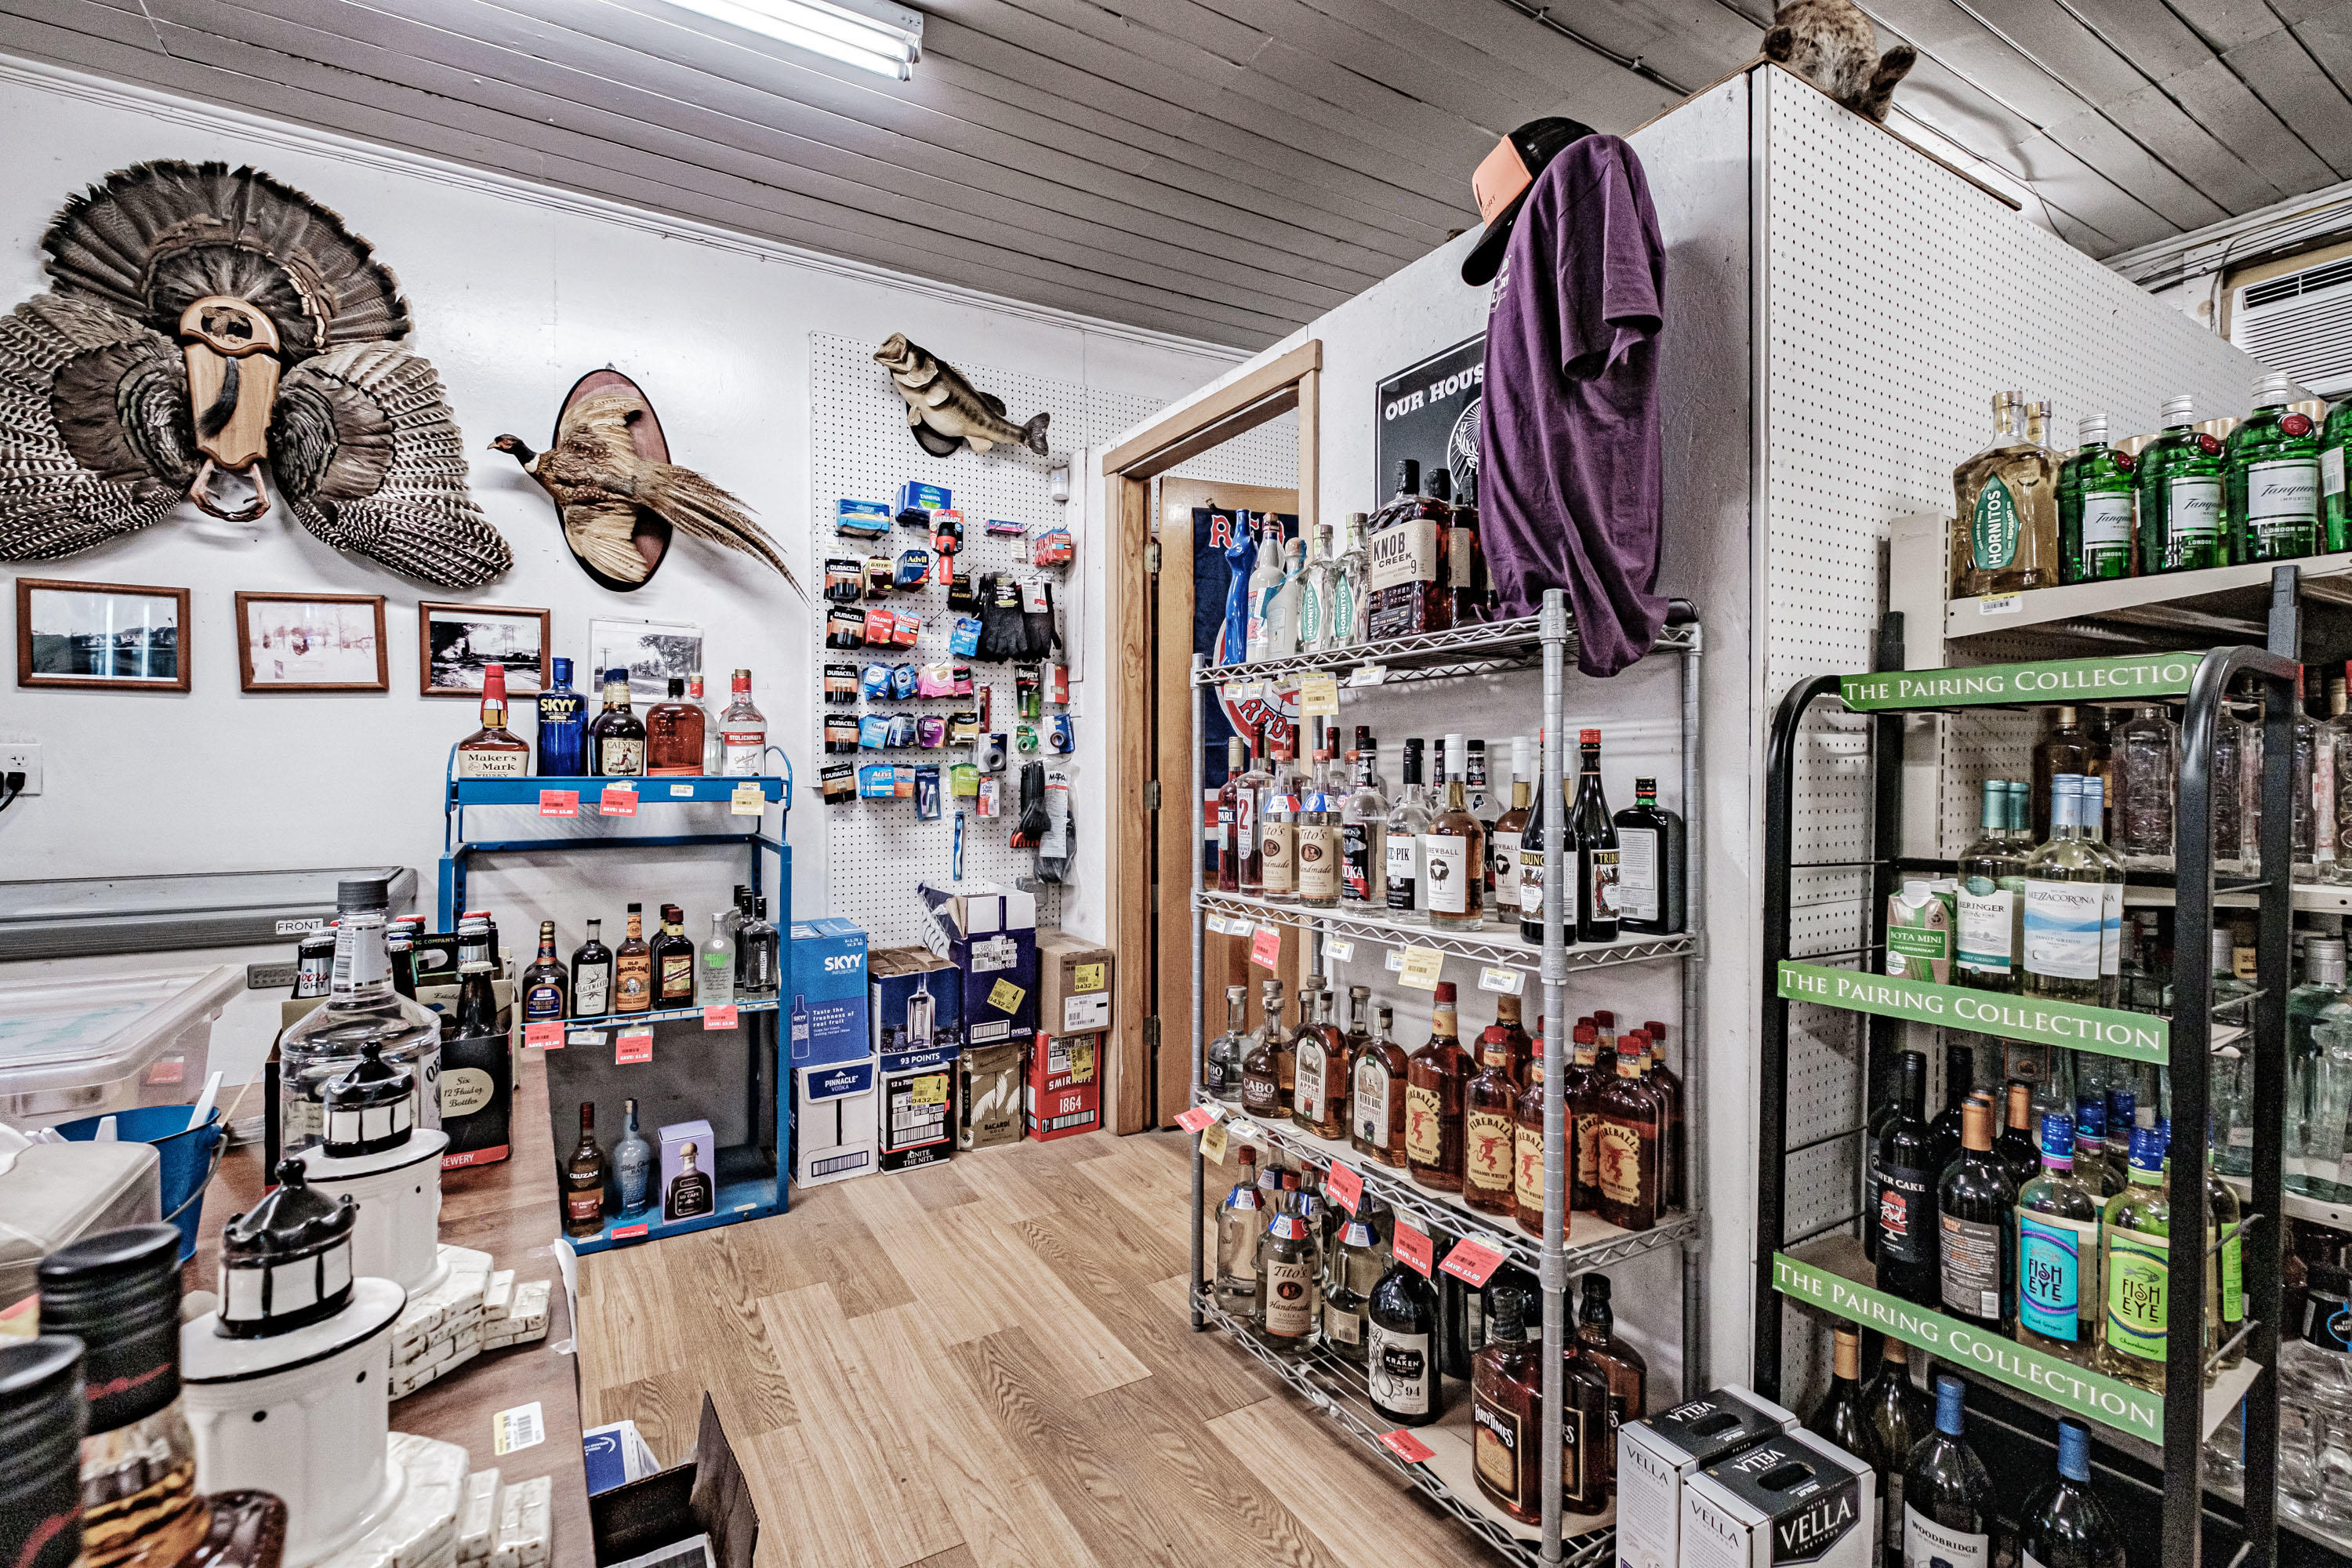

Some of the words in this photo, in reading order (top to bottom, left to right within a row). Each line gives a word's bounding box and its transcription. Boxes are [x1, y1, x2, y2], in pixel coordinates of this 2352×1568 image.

[1385, 390, 1424, 421] OUR
[1430, 363, 1484, 406] HOUS
[1987, 490, 2002, 564] HORNITOS
[1374, 532, 1405, 562] KNOB
[1379, 552, 1411, 568] CREEK
[1411, 559, 1417, 575] 9
[834, 612, 863, 622] DURACELL
[871, 615, 892, 624] TYLENOL
[898, 614, 919, 624] TYLENOL
[1842, 683, 1889, 701] THE
[1898, 676, 2004, 699] PAIRING
[2013, 662, 2199, 691] COLLECTIO
[540, 699, 576, 712] SKYY
[826, 769, 852, 779] DURACELL
[1049, 773, 1066, 782] MAPA
[1239, 799, 1249, 829] 2
[1300, 829, 1327, 840] Tito's
[1396, 848, 1410, 861] PIK
[2028, 891, 2095, 905] MEZZACORONA
[278, 920, 321, 931] FRONT
[1889, 931, 1915, 942] BOTA
[1918, 933, 1942, 944] MINI
[1893, 945, 1936, 953] CHARDONNAY
[825, 953, 862, 971] SKYY
[617, 964, 650, 976] GRAND-DAD
[1094, 966, 1099, 978] 4
[989, 996, 1005, 1007] 0432
[1011, 989, 1020, 1002] 4
[1780, 968, 1828, 995] THE
[1837, 978, 1944, 1014] PAIRING
[1955, 997, 2160, 1051] COLLECTION
[901, 1056, 909, 1065] 93
[911, 1053, 940, 1063] POINTS
[456, 1076, 471, 1086] Six
[826, 1076, 858, 1088] PINNACLE
[935, 1079, 941, 1091] 4
[1243, 1077, 1275, 1094] CABO
[1300, 1082, 1319, 1093] APPLE
[444, 1089, 452, 1098] 12
[448, 1098, 478, 1108] Bottles
[1059, 1095, 1082, 1114] 1864
[1371, 1097, 1381, 1109] DOG
[1469, 1116, 1510, 1135] FIREBALL
[907, 1149, 931, 1159] IGNITE
[1418, 1147, 1432, 1156] WHISKY
[903, 1158, 916, 1167] THE
[569, 1170, 599, 1179] CRUZAN
[1471, 1168, 1490, 1178] CINNAMON
[1329, 1185, 1342, 1198] SAVE:
[1617, 1184, 1634, 1193] WHISKY
[1896, 1179, 1926, 1192] CAKE
[1880, 1206, 1908, 1225] Red
[1396, 1247, 1410, 1261] SAVE:
[1411, 1256, 1427, 1271] $3.00
[1274, 1265, 1308, 1279] Tito's
[1445, 1261, 1463, 1272] SAVE:
[1463, 1269, 1481, 1282] $3.00
[2029, 1258, 2062, 1284] FISH
[2029, 1276, 2062, 1301] EYE
[2122, 1279, 2160, 1305] FISH
[2122, 1297, 2158, 1323] EYE
[1775, 1261, 1823, 1298] THE
[1831, 1283, 1940, 1344] PAIRING
[1949, 1330, 2155, 1430] COLLECTION
[1385, 1356, 1419, 1367] KRAKEN
[1405, 1386, 1420, 1396] 94
[1666, 1401, 1717, 1422] VELLA
[1475, 1403, 1490, 1425] EARLY
[1489, 1411, 1514, 1448] TIMES
[1627, 1444, 1668, 1487] VELLA
[1732, 1449, 1786, 1473] VELLA
[1691, 1500, 1739, 1549] VELLA
[1780, 1496, 1853, 1551] VELLA
[1795, 1529, 1839, 1555] VINEYARDS
[1911, 1519, 1978, 1554] WOODBRIDGE
